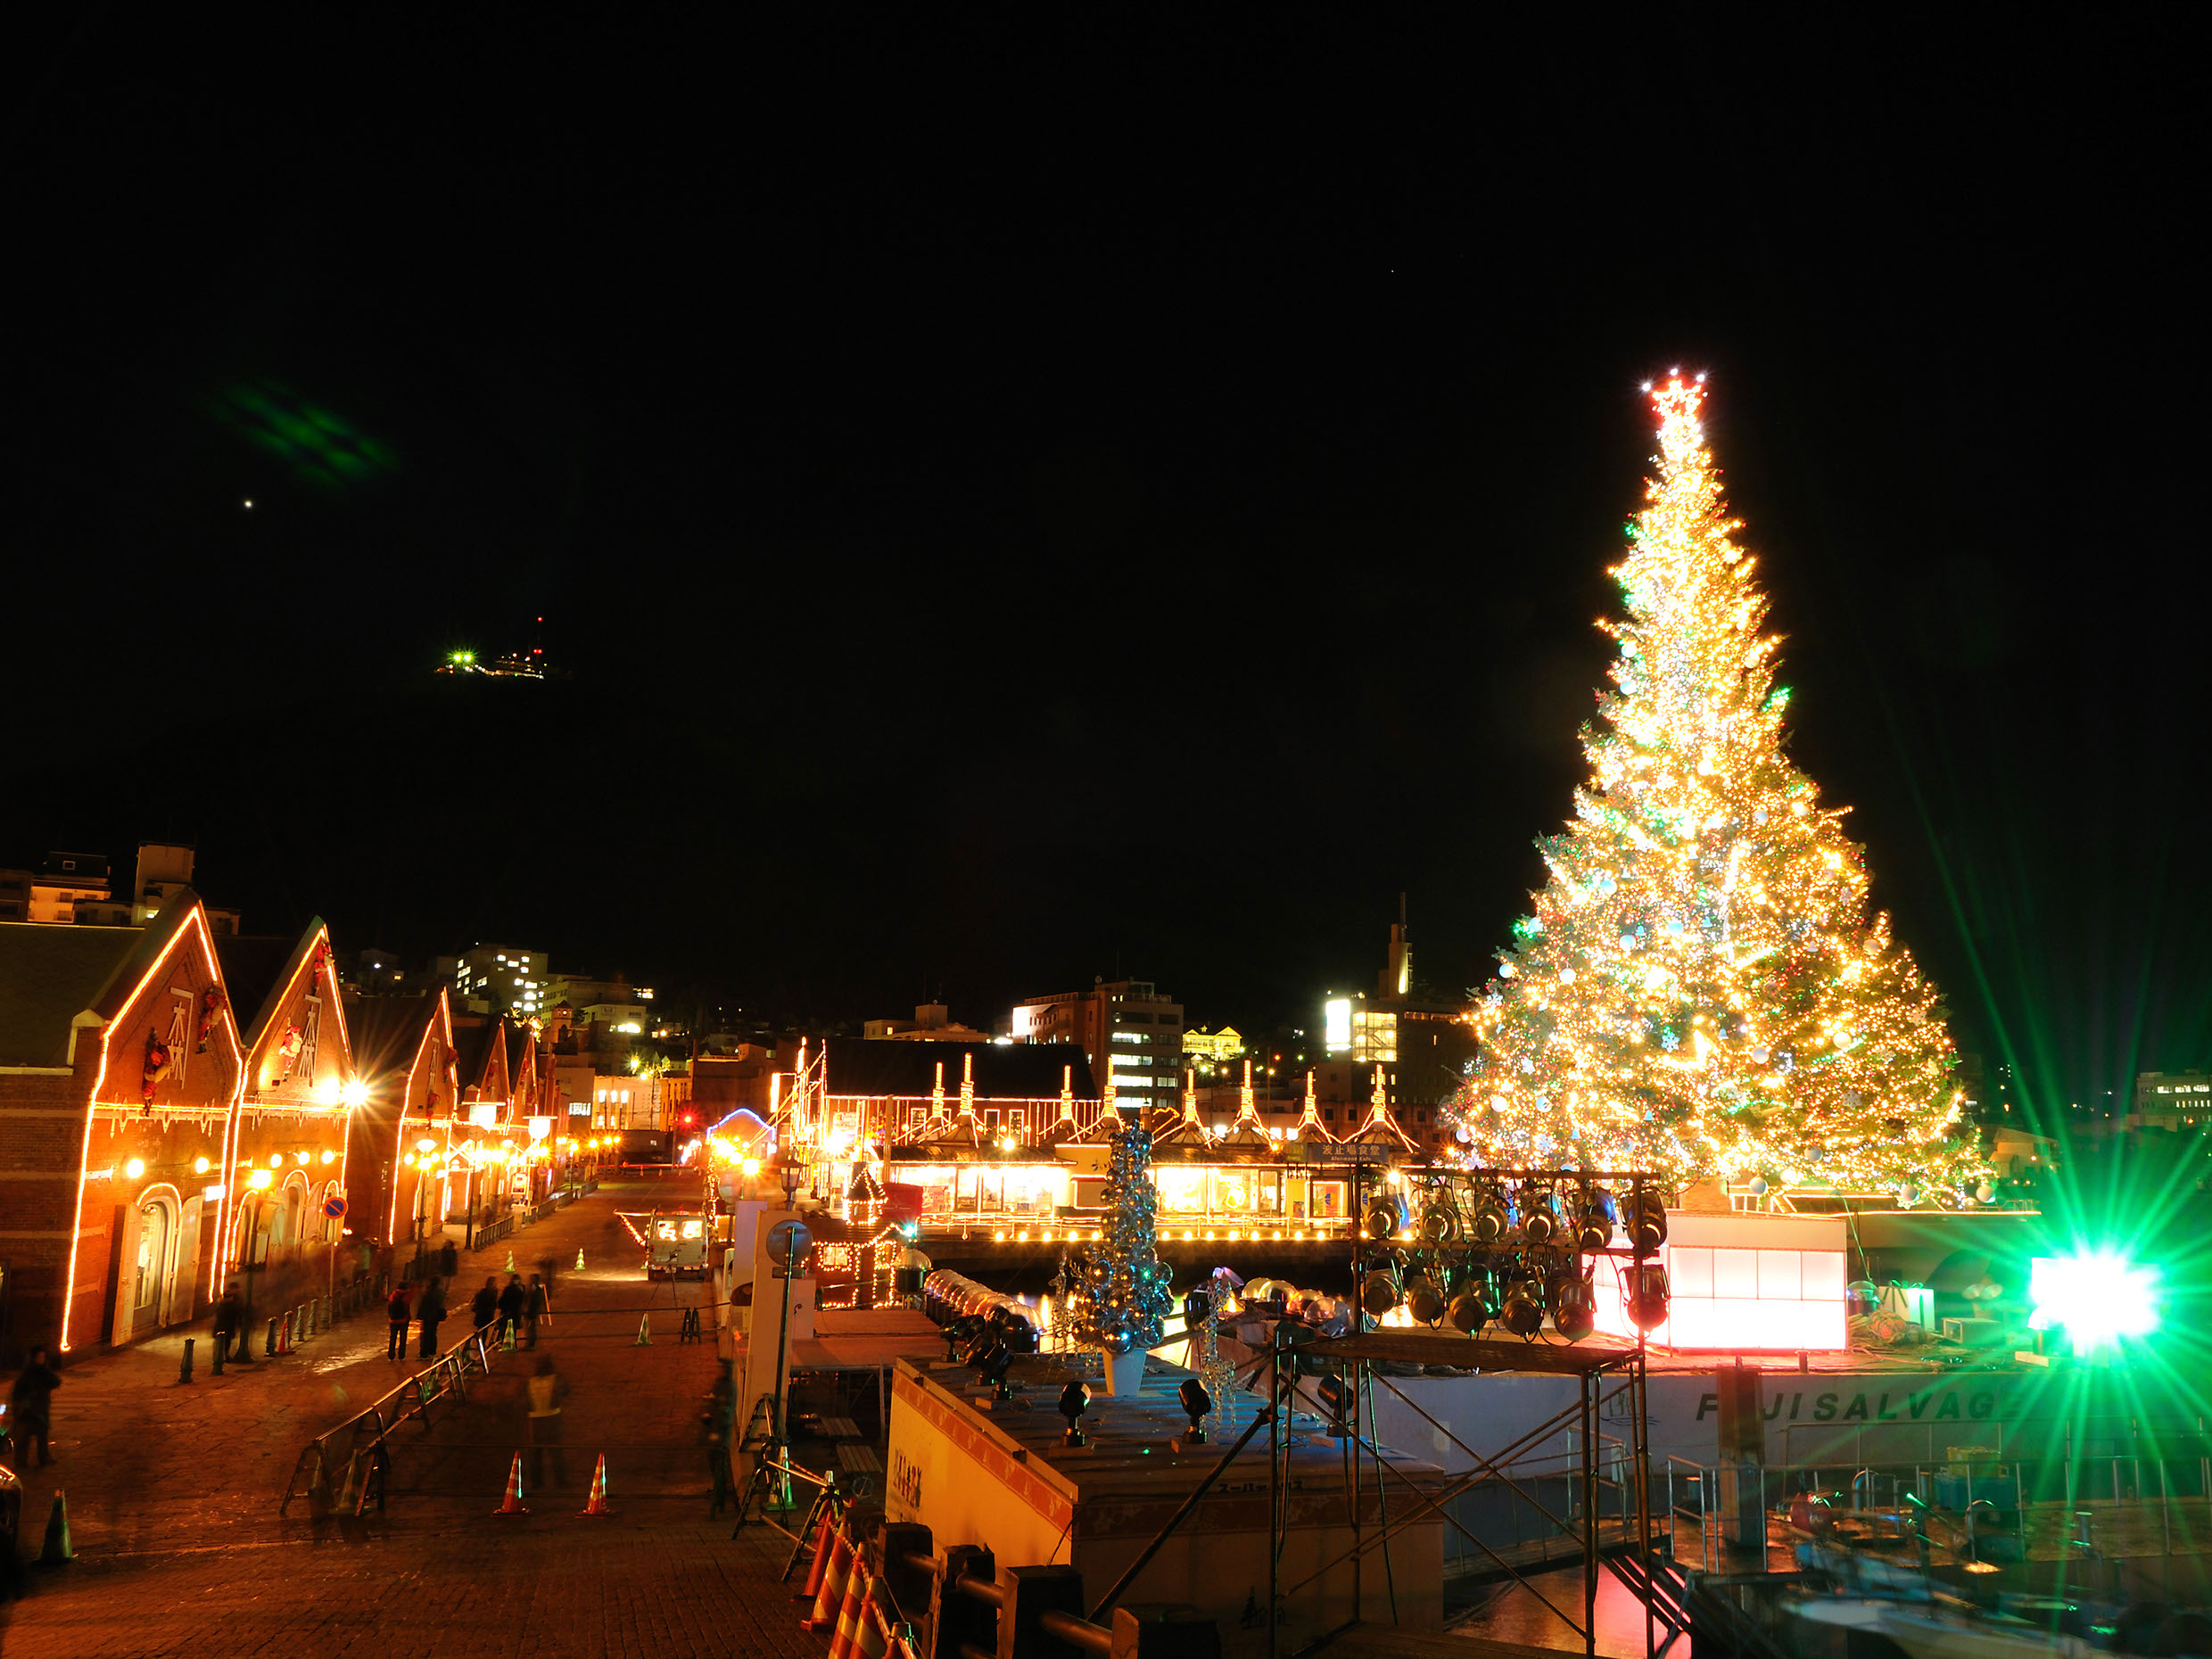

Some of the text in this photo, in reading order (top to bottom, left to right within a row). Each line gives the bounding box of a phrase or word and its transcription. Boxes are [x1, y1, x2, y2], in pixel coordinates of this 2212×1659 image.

[1696, 1392, 1803, 1421] FJI
[1218, 1480, 1304, 1492] スーパース
